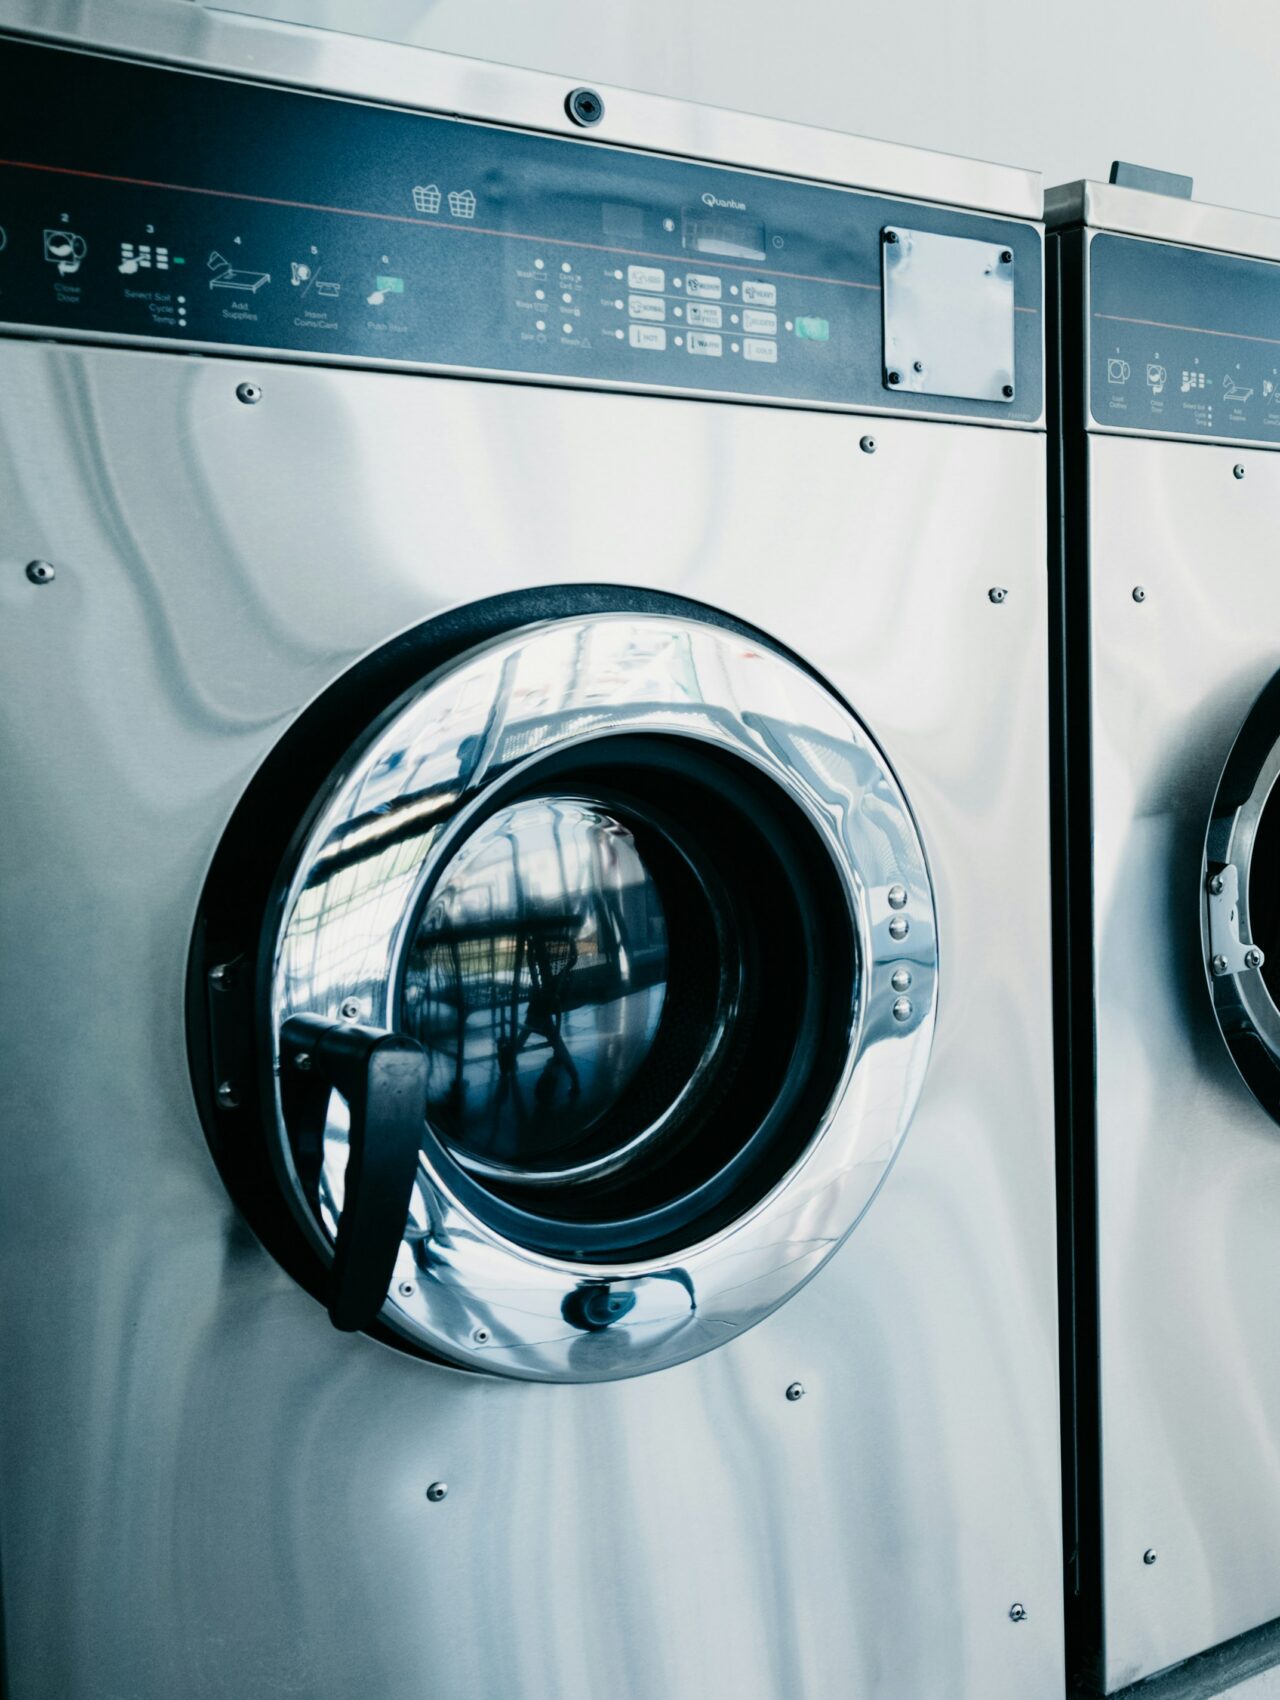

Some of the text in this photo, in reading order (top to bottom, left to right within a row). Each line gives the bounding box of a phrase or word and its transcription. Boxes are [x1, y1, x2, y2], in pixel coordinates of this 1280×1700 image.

[701, 192, 747, 211] Quantum
[60, 212, 69, 223] 2
[146, 224, 155, 234] 3
[233, 236, 242, 245] 4
[310, 245, 318, 255] 5
[382, 255, 389, 264] 6
[149, 303, 174, 314] Cycle
[231, 301, 248, 311] Add
[152, 314, 177, 326] Temp
[222, 310, 258, 321] Supplies
[304, 310, 327, 320] Insert
